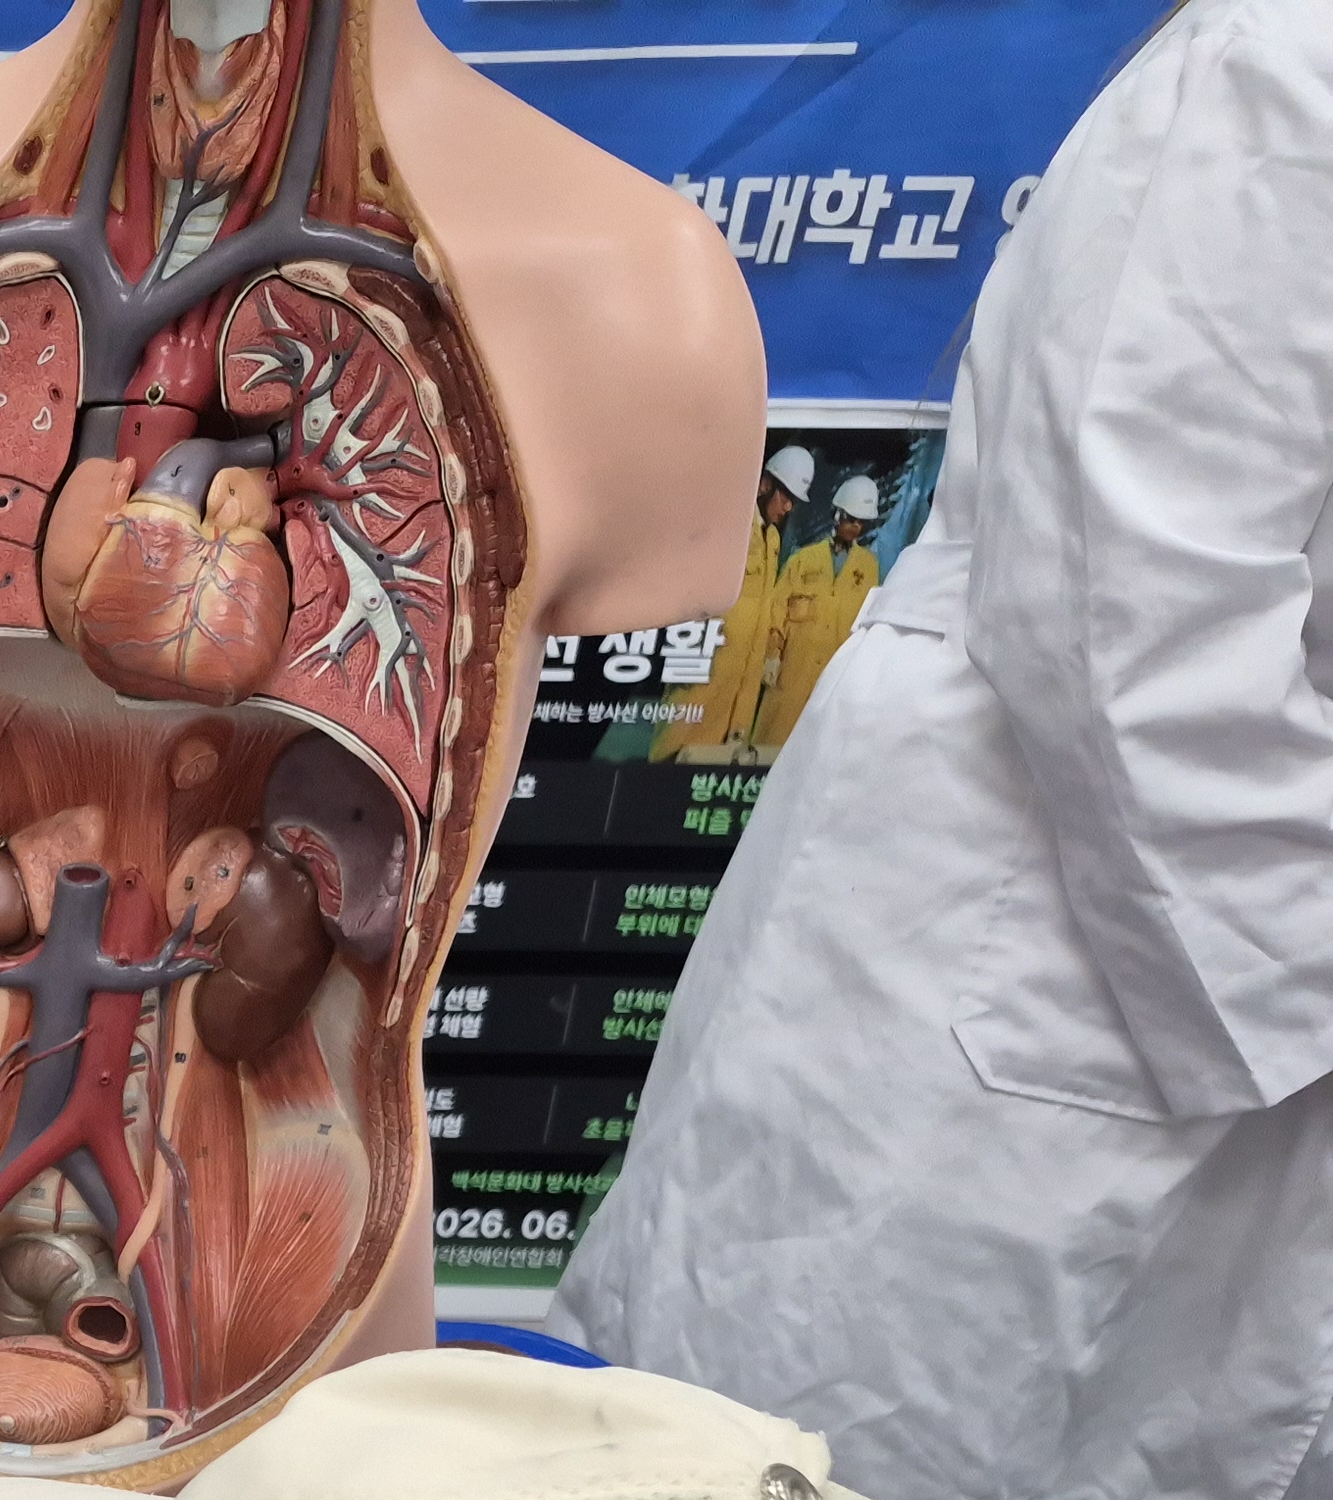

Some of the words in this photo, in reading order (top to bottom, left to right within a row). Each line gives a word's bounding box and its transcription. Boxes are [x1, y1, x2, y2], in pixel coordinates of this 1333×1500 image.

[598, 617, 727, 684] 생활
[587, 701, 638, 725] 방사선
[624, 883, 719, 912] 인체모형
[433, 1207, 513, 1240] 026.
[521, 1209, 577, 1241] 06.
[433, 1244, 564, 1269] 각장애인연합회
